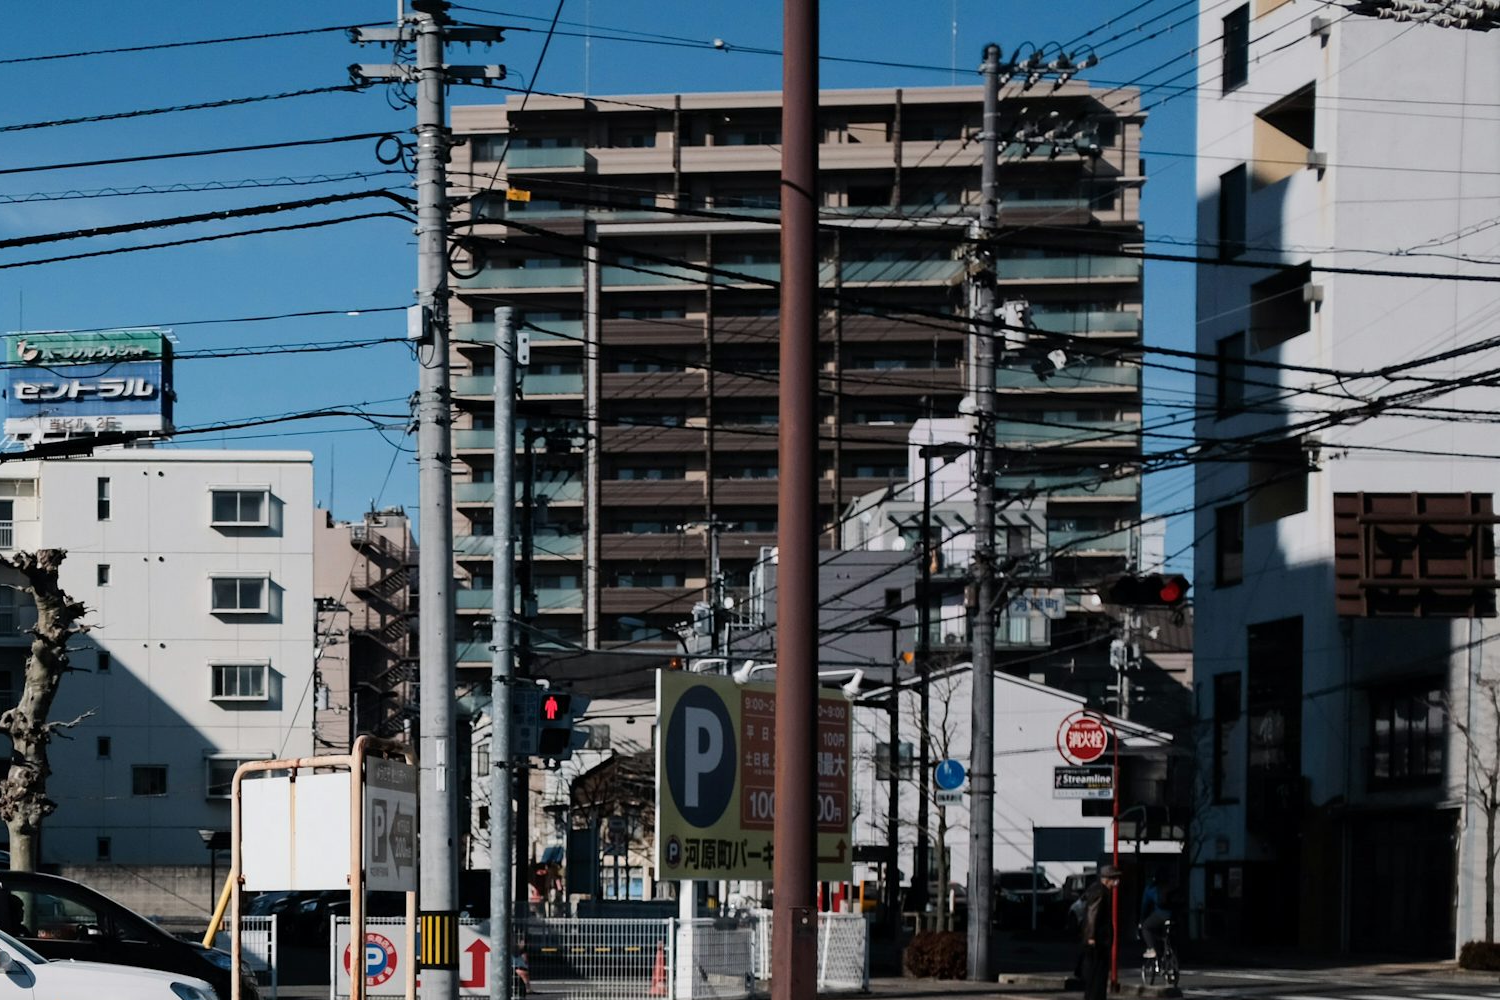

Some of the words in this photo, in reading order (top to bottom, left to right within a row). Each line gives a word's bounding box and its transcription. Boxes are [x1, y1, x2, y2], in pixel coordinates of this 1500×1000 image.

[13, 378, 154, 400] セントラル
[1068, 731, 1103, 749] 消火栓
[684, 706, 724, 807] P
[1062, 773, 1112, 785] Streamline
[374, 805, 385, 857] P
